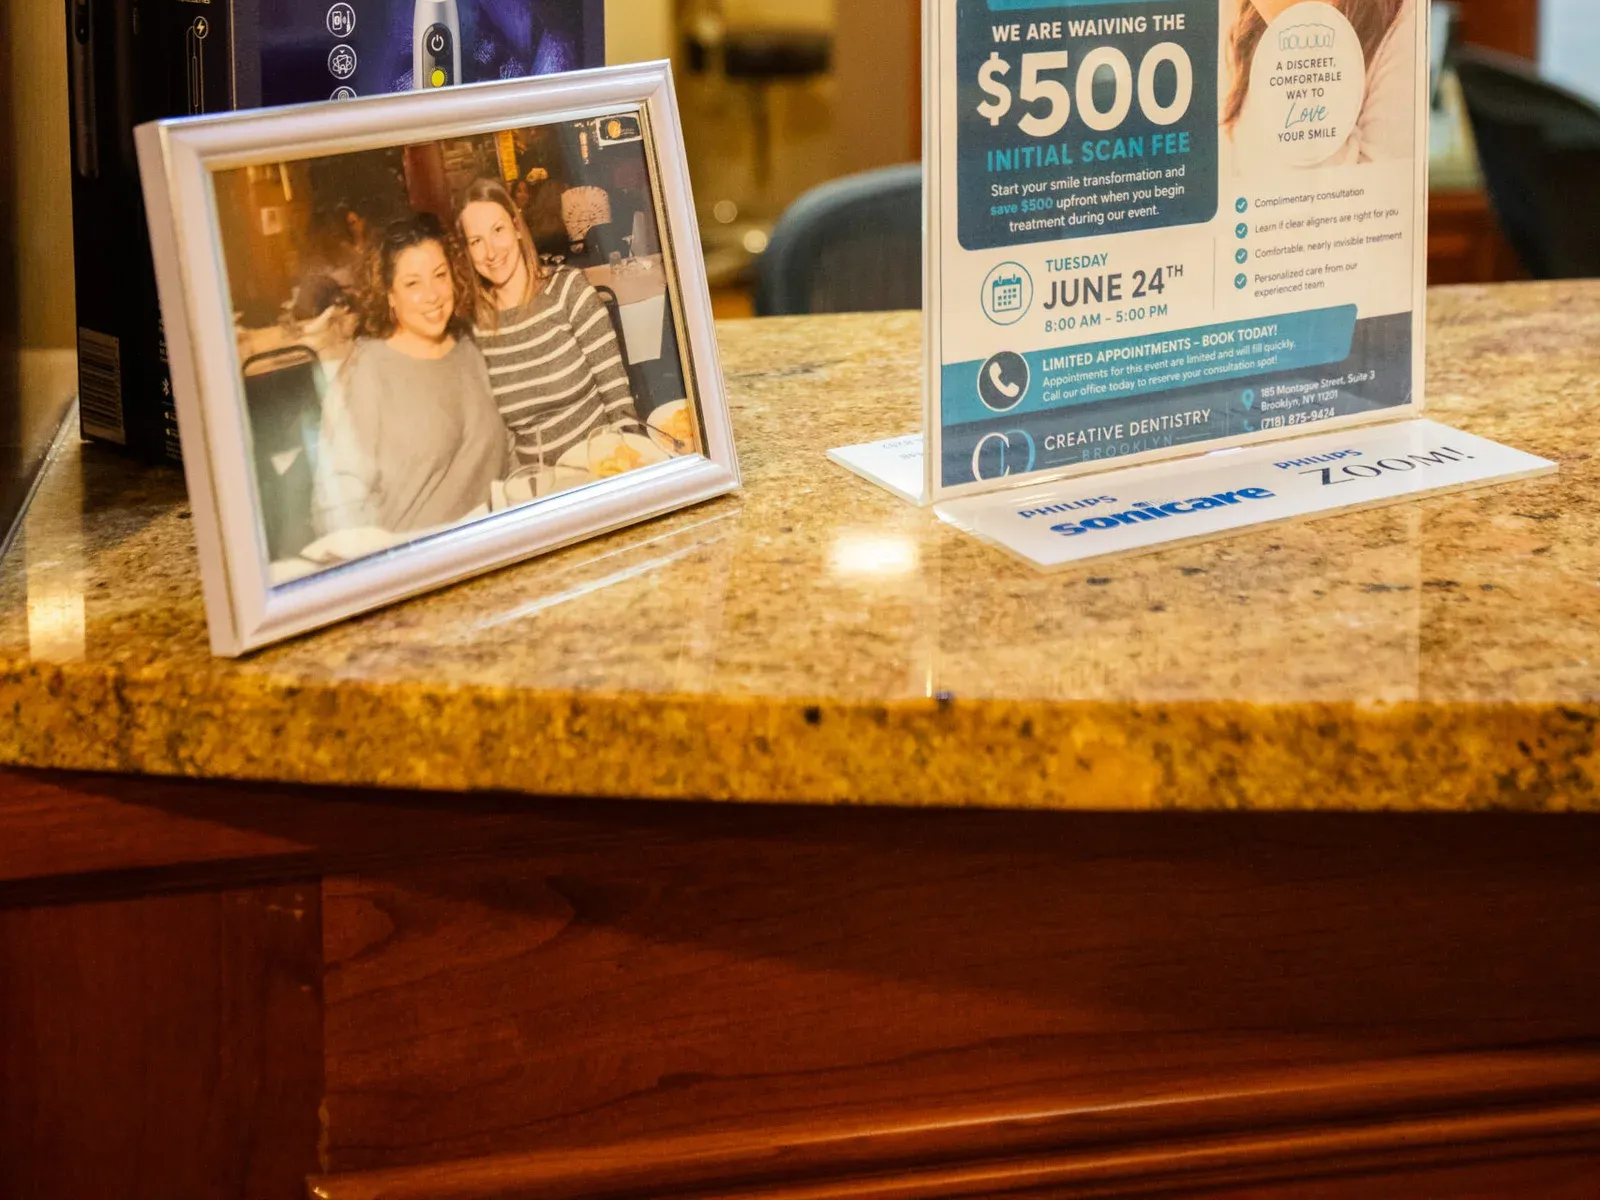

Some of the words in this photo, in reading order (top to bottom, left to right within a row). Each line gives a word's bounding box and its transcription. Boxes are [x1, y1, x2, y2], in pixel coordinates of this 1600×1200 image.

[992, 24, 1021, 43] WE
[1026, 21, 1062, 40] ARE
[1068, 16, 1147, 37] WAIVING
[1152, 13, 1186, 31] THE
[1276, 61, 1283, 71] A
[1287, 57, 1337, 70] DISCREET,
[976, 41, 1193, 138] $500
[1269, 71, 1342, 87] COMFORTABLE
[1286, 89, 1308, 100] WAY
[1312, 87, 1325, 98] TO
[1285, 102, 1328, 129] Love
[1277, 130, 1305, 143] YOUR
[1308, 127, 1337, 140] SMILE
[987, 143, 1073, 172] INITIAL
[1081, 136, 1144, 163] SCAN
[1152, 131, 1191, 156] FEE
[991, 183, 1018, 197] Start
[1022, 181, 1047, 196] your
[1050, 177, 1080, 190] smile
[1083, 169, 1162, 187] transformation
[1165, 165, 1186, 177] and
[990, 204, 1018, 216] save
[1021, 197, 1054, 213] $500
[1056, 193, 1100, 211] upfront
[1101, 190, 1129, 203] when
[1132, 189, 1152, 203] you
[1154, 183, 1186, 198] begin
[1254, 193, 1315, 209] Complimentary
[1317, 187, 1365, 201] consultation
[1009, 214, 1065, 232] treatment
[1068, 209, 1104, 225] during
[1107, 209, 1126, 220] our
[1128, 205, 1160, 218] event.
[1255, 223, 1277, 233] Learn
[1278, 221, 1284, 230] if
[1285, 219, 1305, 229] clear
[1306, 215, 1337, 228] aligners
[1339, 215, 1352, 223] are
[1353, 210, 1372, 222] right
[1373, 209, 1384, 218] for
[1385, 208, 1399, 219] you
[1255, 243, 1304, 259] Comfortable,
[1307, 240, 1331, 251] nearly
[1333, 236, 1364, 248] invisible
[1366, 231, 1403, 243] treatment
[1045, 253, 1108, 272] TUESDAY
[1254, 269, 1304, 283] Personalized
[1305, 267, 1323, 277] care
[1325, 263, 1344, 273] from
[1345, 262, 1358, 271] our
[1043, 273, 1122, 310] JUNE
[1132, 264, 1184, 298] 24TH
[1254, 282, 1303, 298] experienced
[1305, 279, 1325, 290] team
[1045, 317, 1075, 332] 8:00
[1080, 313, 1101, 328] AM
[1116, 307, 1145, 323] 5:00
[1150, 304, 1168, 317] PM
[1042, 353, 1093, 372] LIMITED
[1096, 338, 1191, 363] APPOINTMENTS
[1202, 331, 1235, 347] BOOK
[1237, 325, 1278, 343] TODAY!
[1043, 369, 1109, 388] Appointments
[1110, 365, 1124, 377] for
[1126, 362, 1143, 375] this
[1144, 360, 1170, 372] event
[1170, 357, 1185, 368] are
[1187, 351, 1217, 365] limited
[1218, 349, 1234, 360] and
[1236, 345, 1250, 357] will
[1251, 343, 1263, 354] fill
[1264, 338, 1296, 355] quickly.
[1042, 388, 1061, 402] Call
[1062, 388, 1078, 399] our
[1080, 382, 1107, 397] office
[1109, 379, 1135, 395] today
[1137, 377, 1147, 387] to
[1148, 373, 1180, 385] reserve
[1182, 369, 1202, 382] your
[1203, 361, 1256, 377] consultation
[1257, 355, 1278, 369] spot!
[1261, 388, 1275, 398] 185
[1276, 381, 1319, 397] Montague
[1347, 372, 1367, 383] Suite
[1369, 370, 1376, 380] 3
[1261, 397, 1300, 412] Brooklyn,
[1302, 394, 1316, 405] NY
[1318, 389, 1338, 402] 11201
[1044, 424, 1124, 451] CREATIVE
[1129, 408, 1211, 436] DENTISTRY
[1261, 414, 1285, 431] (718)
[1288, 407, 1336, 425] 875-9424
[1082, 435, 1173, 461] BROOKLYN
[1273, 449, 1363, 470] PHILIPS
[1298, 446, 1475, 486] ZOOM!
[1017, 495, 1118, 519] PHILIPS
[1050, 487, 1277, 537] sonicare
